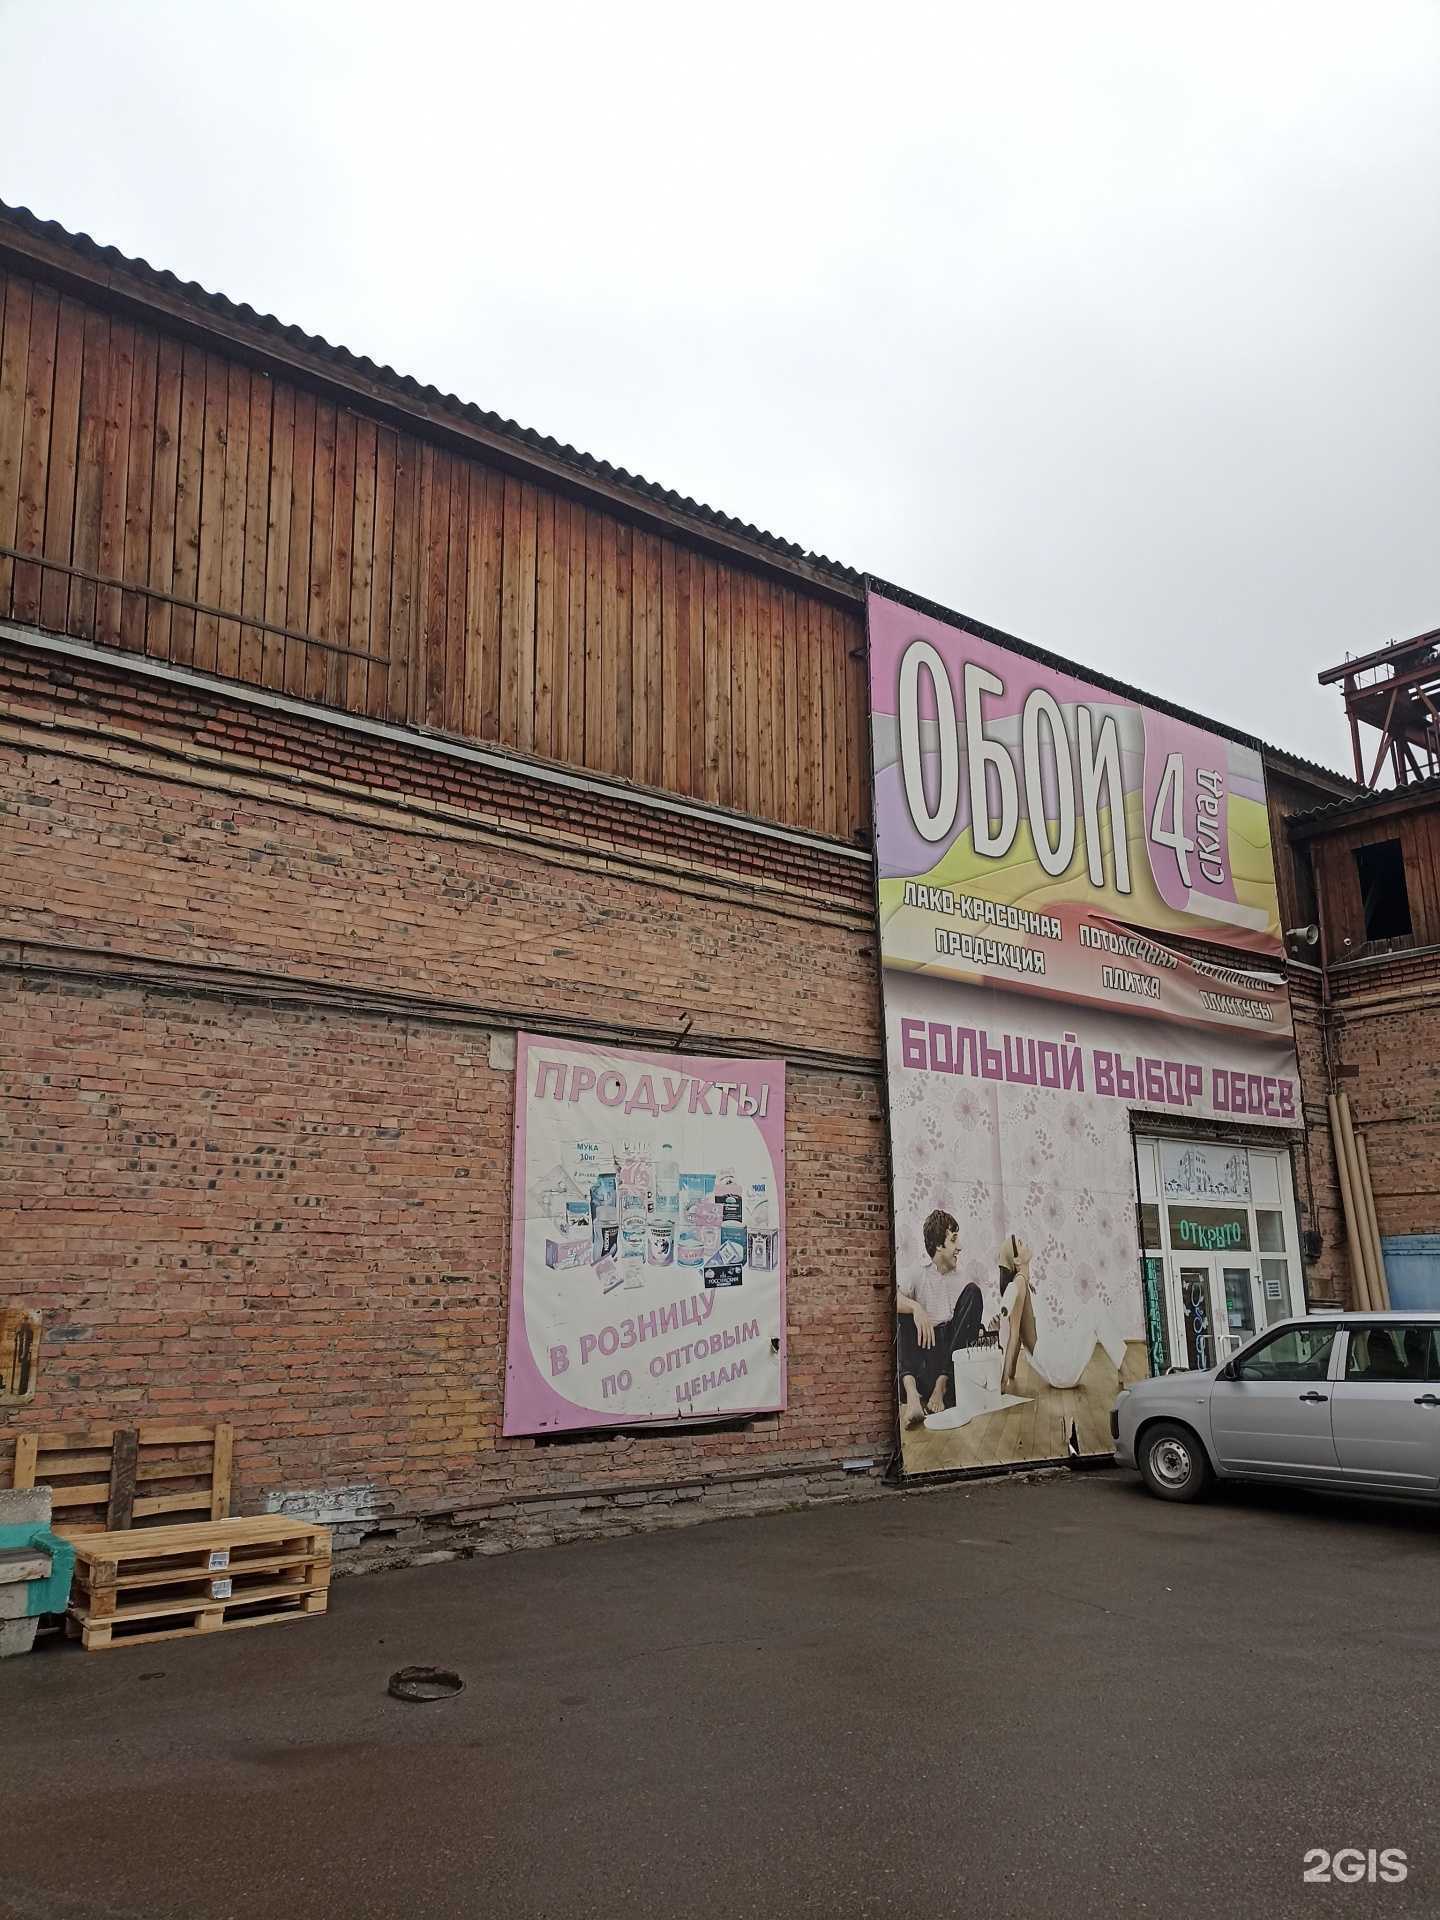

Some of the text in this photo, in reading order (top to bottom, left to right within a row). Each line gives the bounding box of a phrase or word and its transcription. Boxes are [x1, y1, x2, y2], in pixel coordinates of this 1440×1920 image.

[899, 640, 1131, 894] ОБОИ
[1150, 752, 1195, 888] 4
[903, 880, 1062, 941] ЛАКО-КРАСОЧНАЯ
[935, 928, 1046, 975] ПРОДУКЦИЯ
[1079, 924, 1180, 970] ПОТОЛОЧНАЯ
[1102, 964, 1161, 1000] ПЛИТКА
[1199, 989, 1274, 1022] ПЛИНТУСЫ
[534, 1060, 769, 1118] ПРОДУКТЫ
[901, 1017, 1296, 1119] БОЛЬШОЙ ВЫБОР ОБОЕВ
[576, 1143, 599, 1151] МУКА
[1179, 1219, 1241, 1250] ОТКРЫТО
[549, 1289, 716, 1377] В РОЗНИЦУ
[601, 1319, 760, 1399] ПО ОПТОВЫМ
[675, 1358, 749, 1403] ЦЕНАМ
